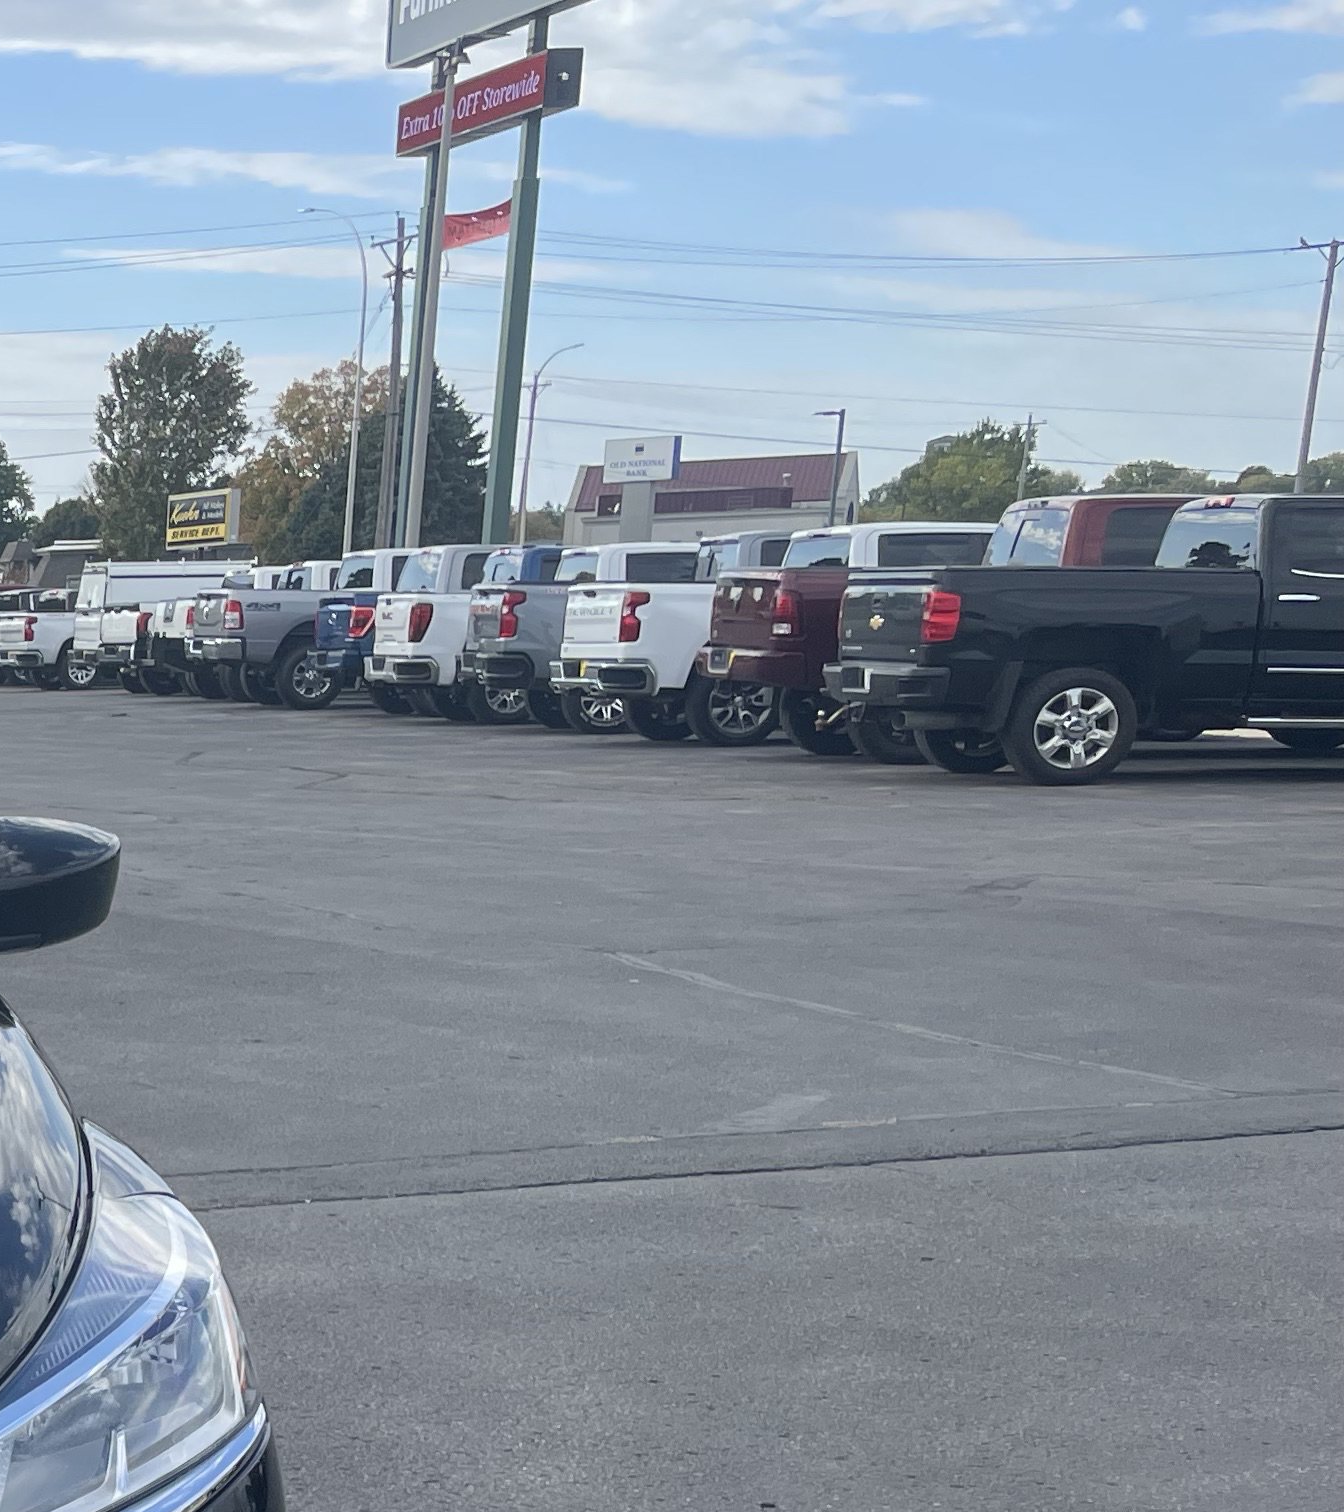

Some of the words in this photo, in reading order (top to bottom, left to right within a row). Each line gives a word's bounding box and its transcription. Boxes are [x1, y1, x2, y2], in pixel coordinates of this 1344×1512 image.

[401, 115, 429, 139] Extra
[432, 104, 455, 129] 10
[457, 90, 482, 119] OFF
[482, 70, 540, 111] Storewide
[627, 459, 665, 467] NATIONAL
[626, 469, 648, 477] BANK
[170, 500, 200, 525] Kuehn
[172, 528, 200, 539] SERVICE
